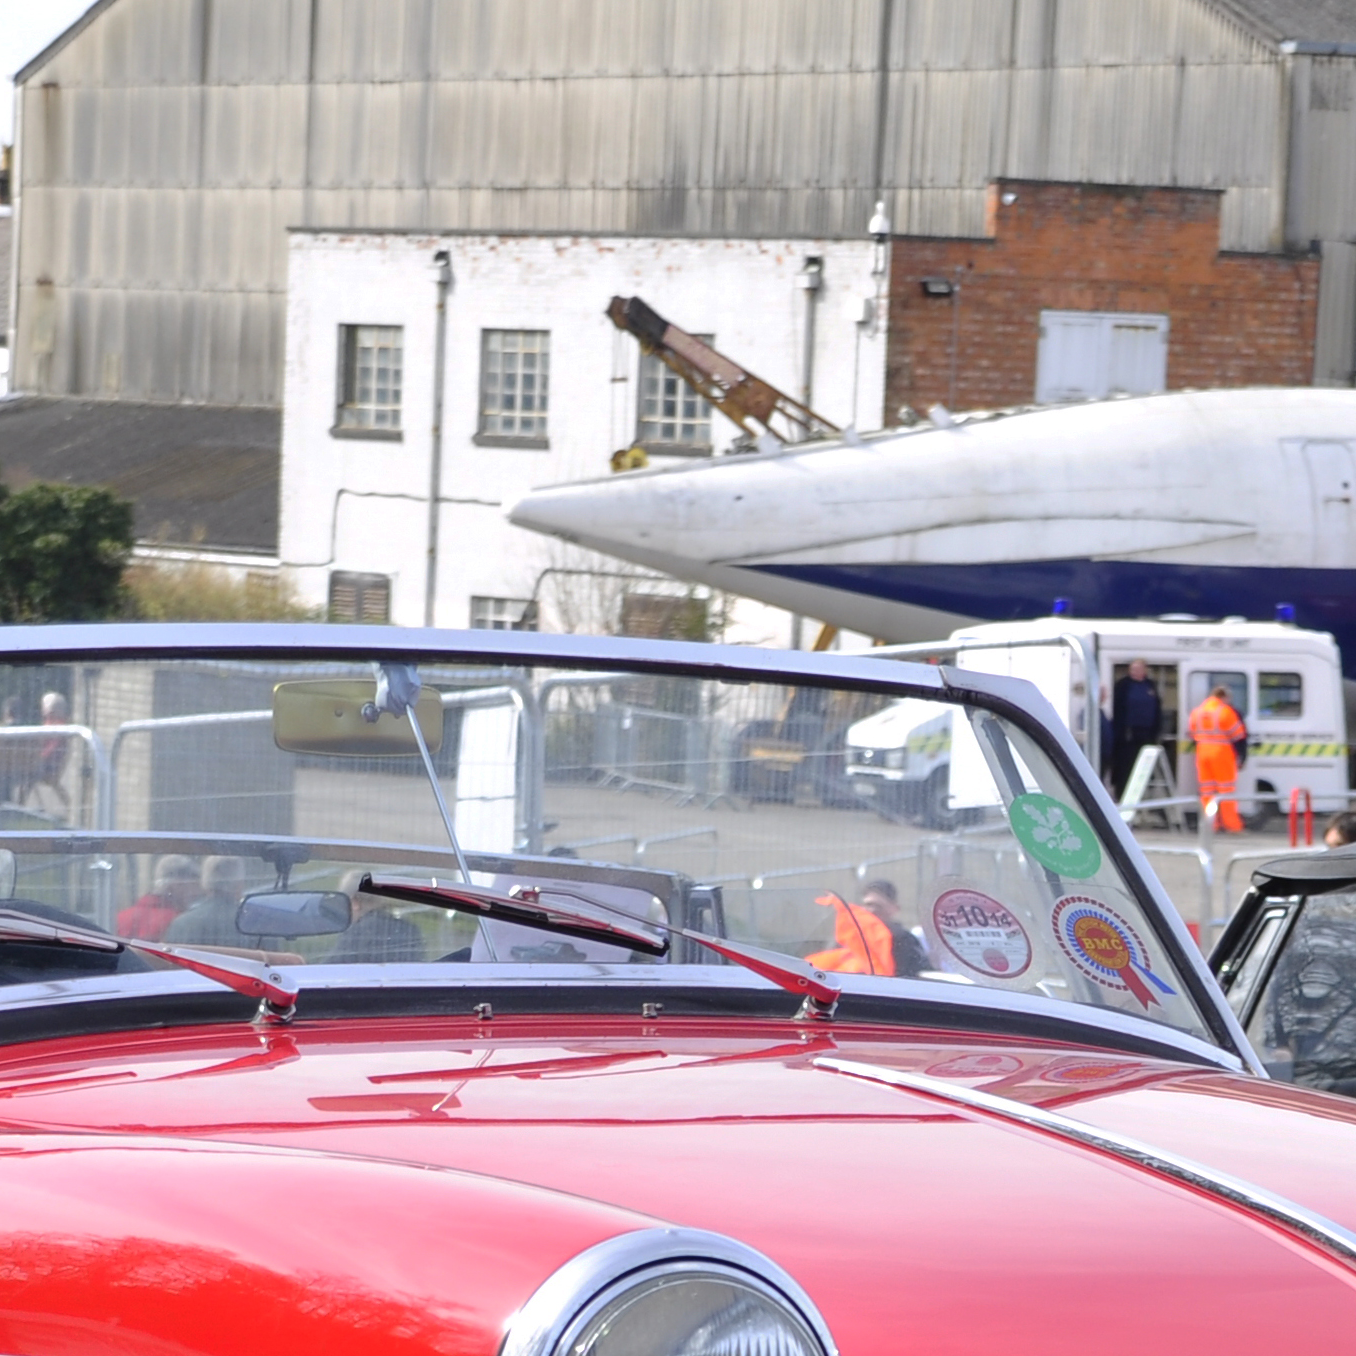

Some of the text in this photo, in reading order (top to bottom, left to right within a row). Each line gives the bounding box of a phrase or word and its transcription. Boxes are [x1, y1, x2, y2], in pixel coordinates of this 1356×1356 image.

[957, 904, 990, 928] 10
[989, 911, 1013, 928] 14
[1081, 937, 1124, 951] BMC
